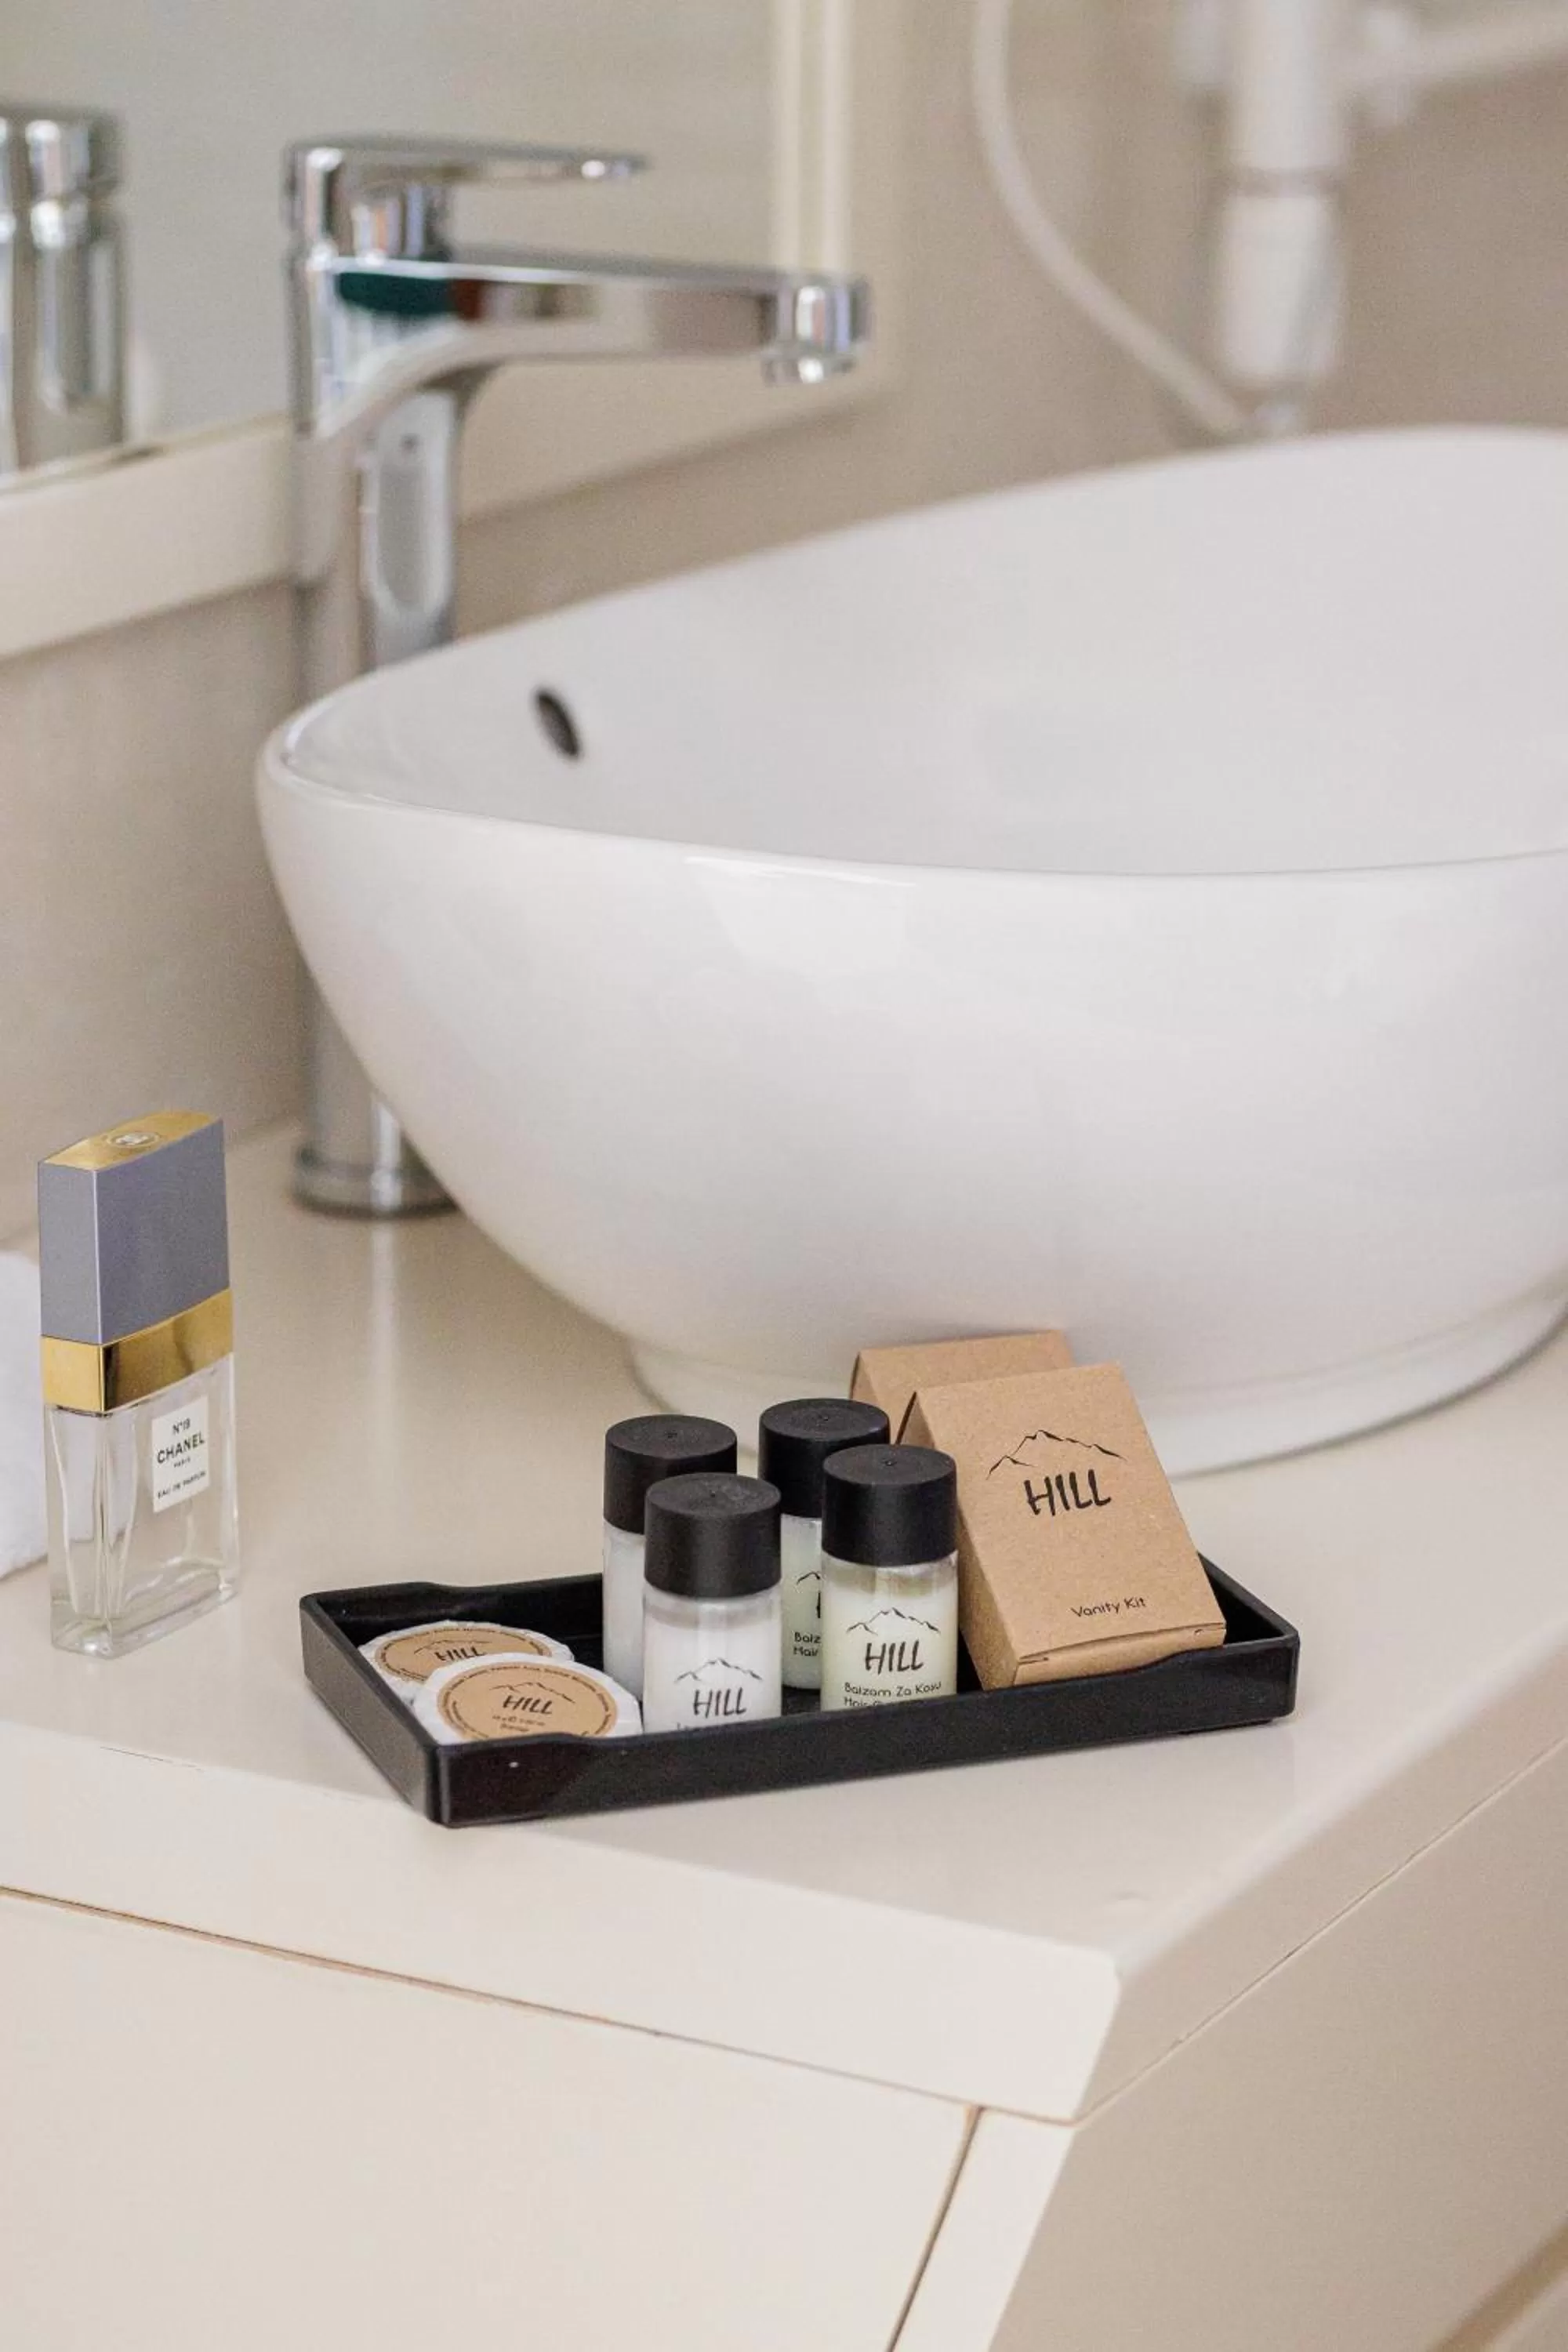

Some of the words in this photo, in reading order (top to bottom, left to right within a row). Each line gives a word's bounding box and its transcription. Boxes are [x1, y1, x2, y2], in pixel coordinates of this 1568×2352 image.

[157, 1431, 205, 1464] CHANEL
[1024, 1469, 1111, 1515] HILL
[1070, 1602, 1120, 1617] Vanity
[1123, 1597, 1145, 1609] Kit
[435, 1646, 487, 1661] HILL
[865, 1639, 924, 1675] HILL
[693, 1686, 747, 1719] HILL
[844, 1682, 891, 1697] Balzam
[896, 1685, 912, 1697] Za
[503, 1695, 553, 1715] HILL
